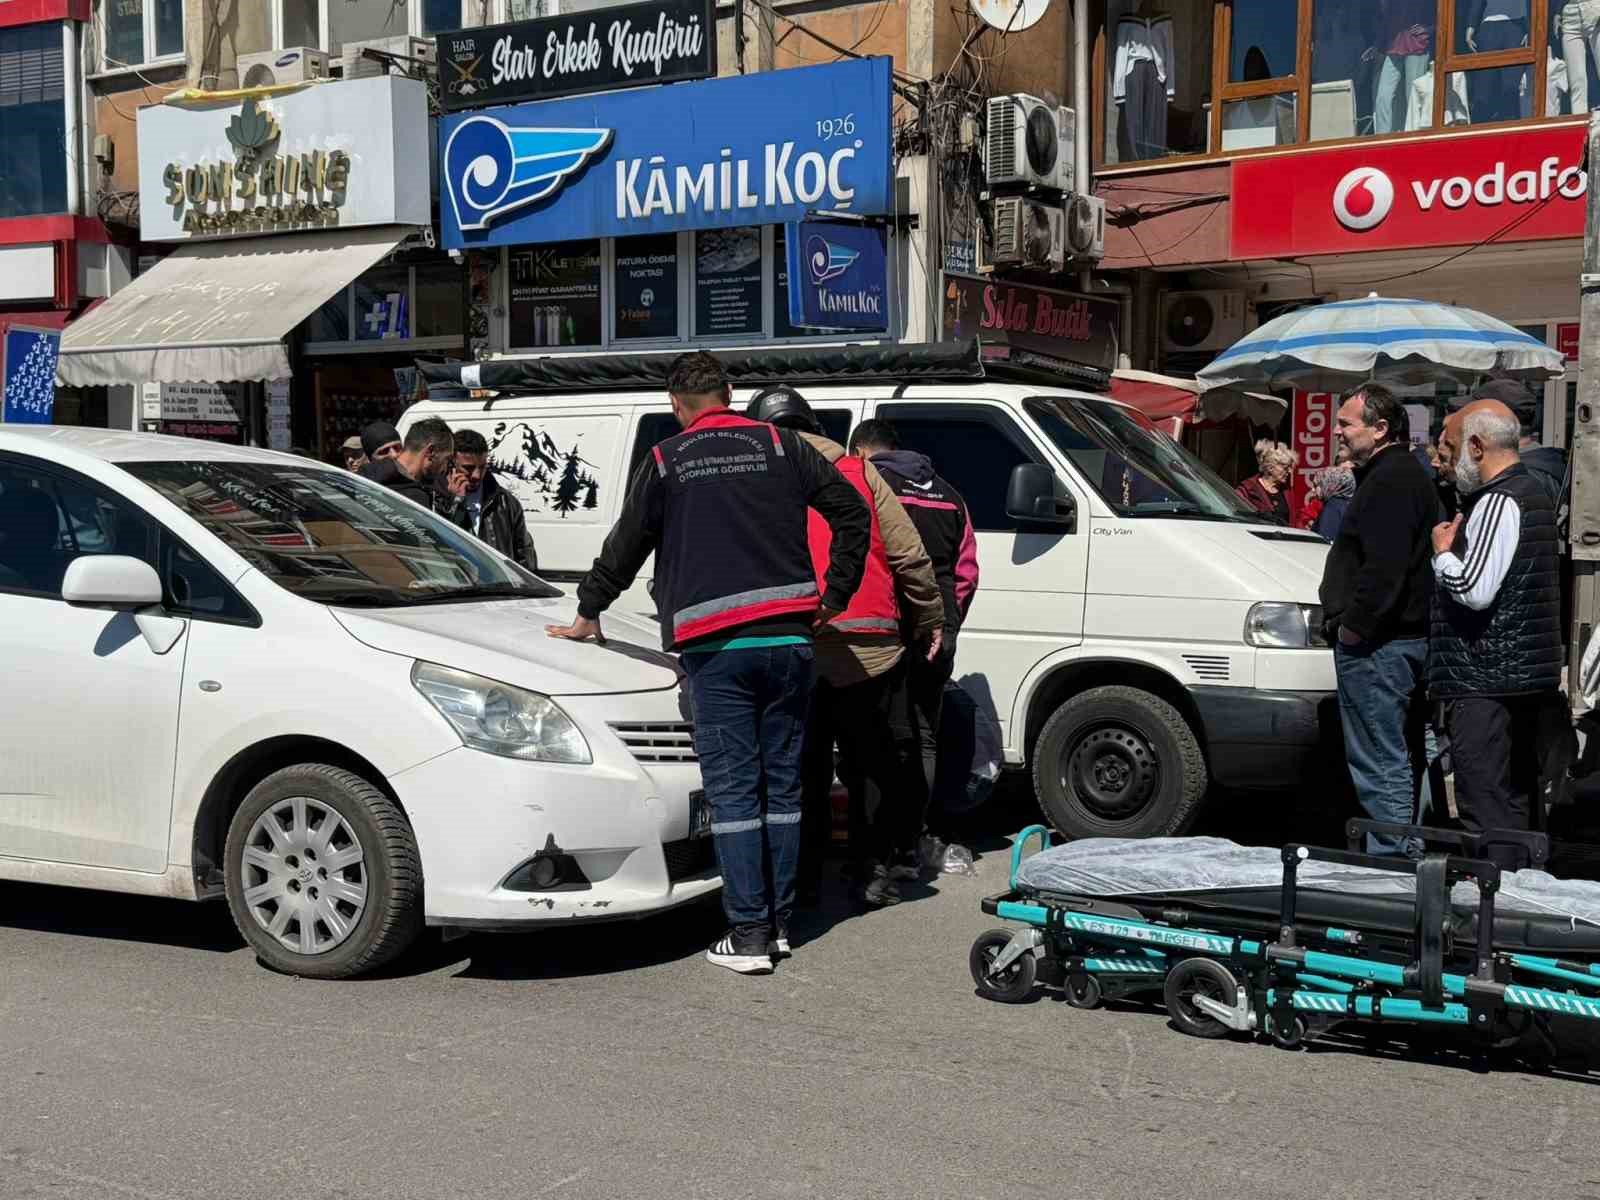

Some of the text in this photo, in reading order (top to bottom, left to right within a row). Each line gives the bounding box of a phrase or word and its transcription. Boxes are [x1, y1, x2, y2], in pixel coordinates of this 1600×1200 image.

[452, 39, 475, 53] HAIR
[491, 13, 703, 85] Star Erkek Kuaförü
[816, 113, 855, 142] 1926
[1034, 294, 1089, 341] Butik
[679, 466, 719, 482] OTOPARK
